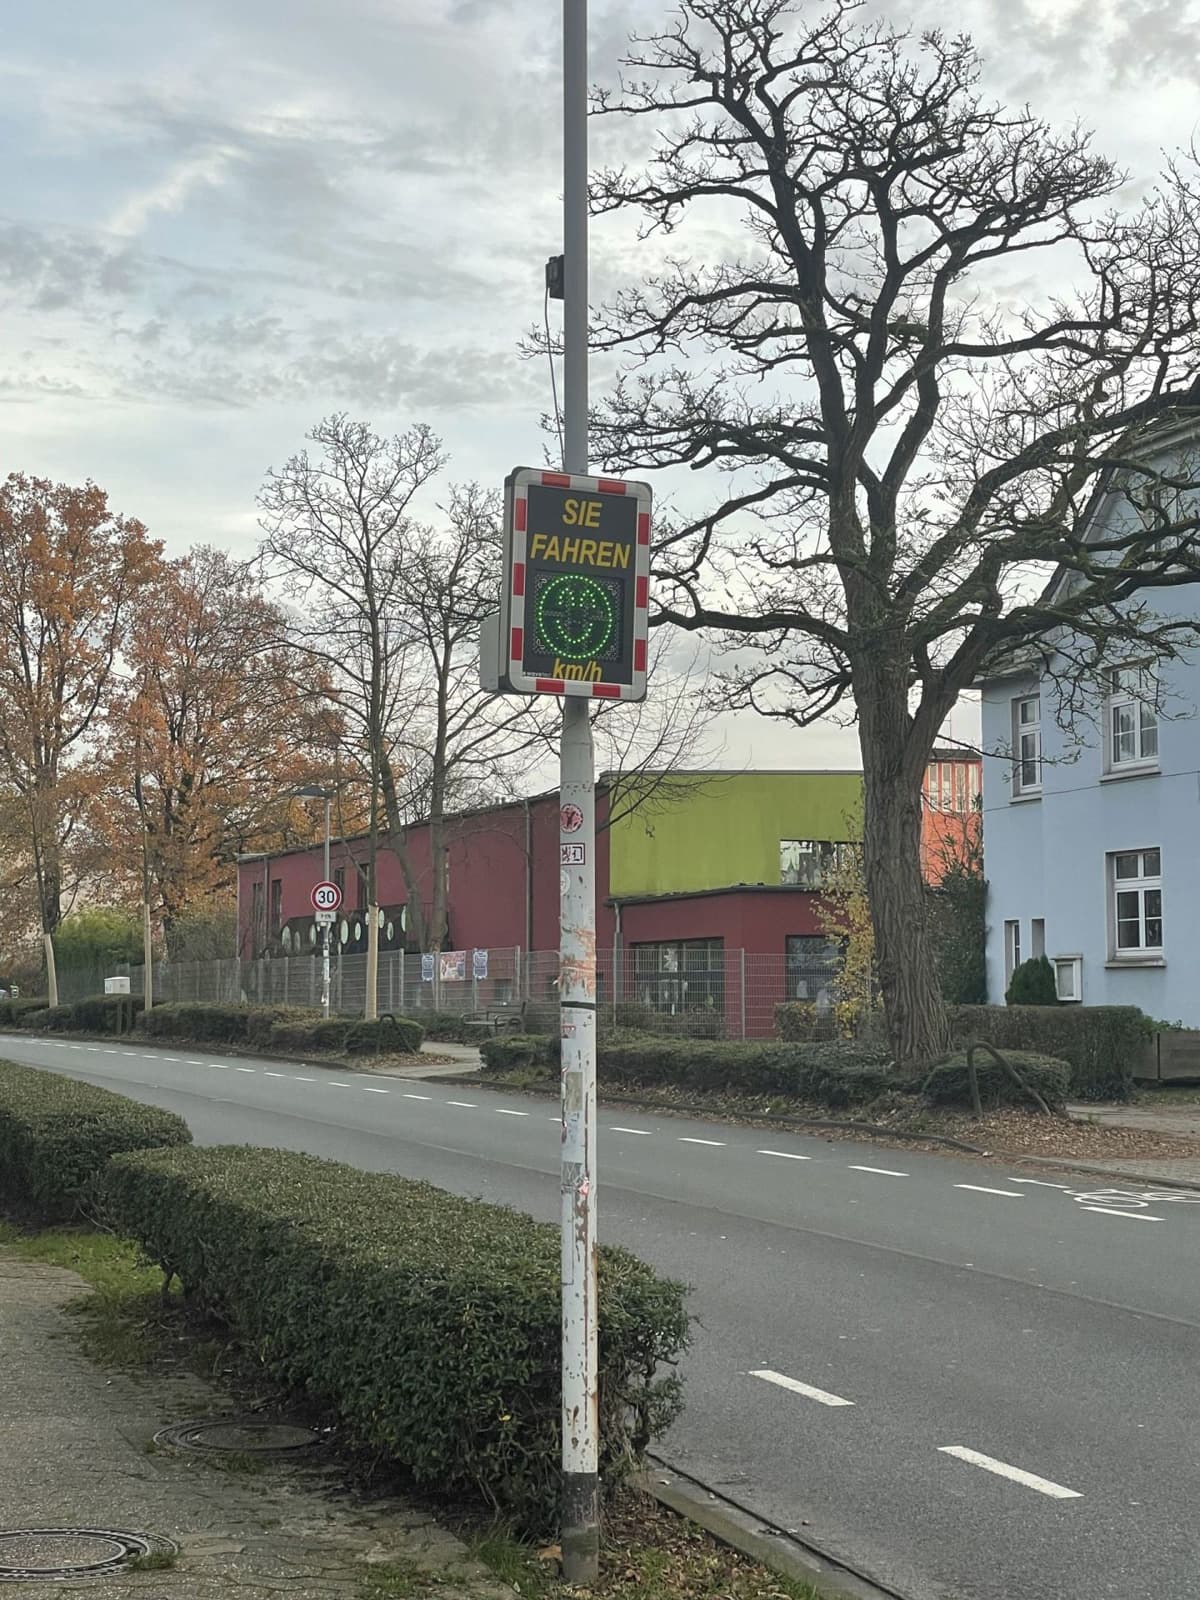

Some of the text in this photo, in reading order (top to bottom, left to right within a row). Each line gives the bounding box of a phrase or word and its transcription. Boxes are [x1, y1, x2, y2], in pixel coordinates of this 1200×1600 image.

[562, 499, 603, 528] SIE
[530, 533, 631, 569] FAHREN
[553, 657, 603, 682] km/h
[318, 890, 335, 904] 30
